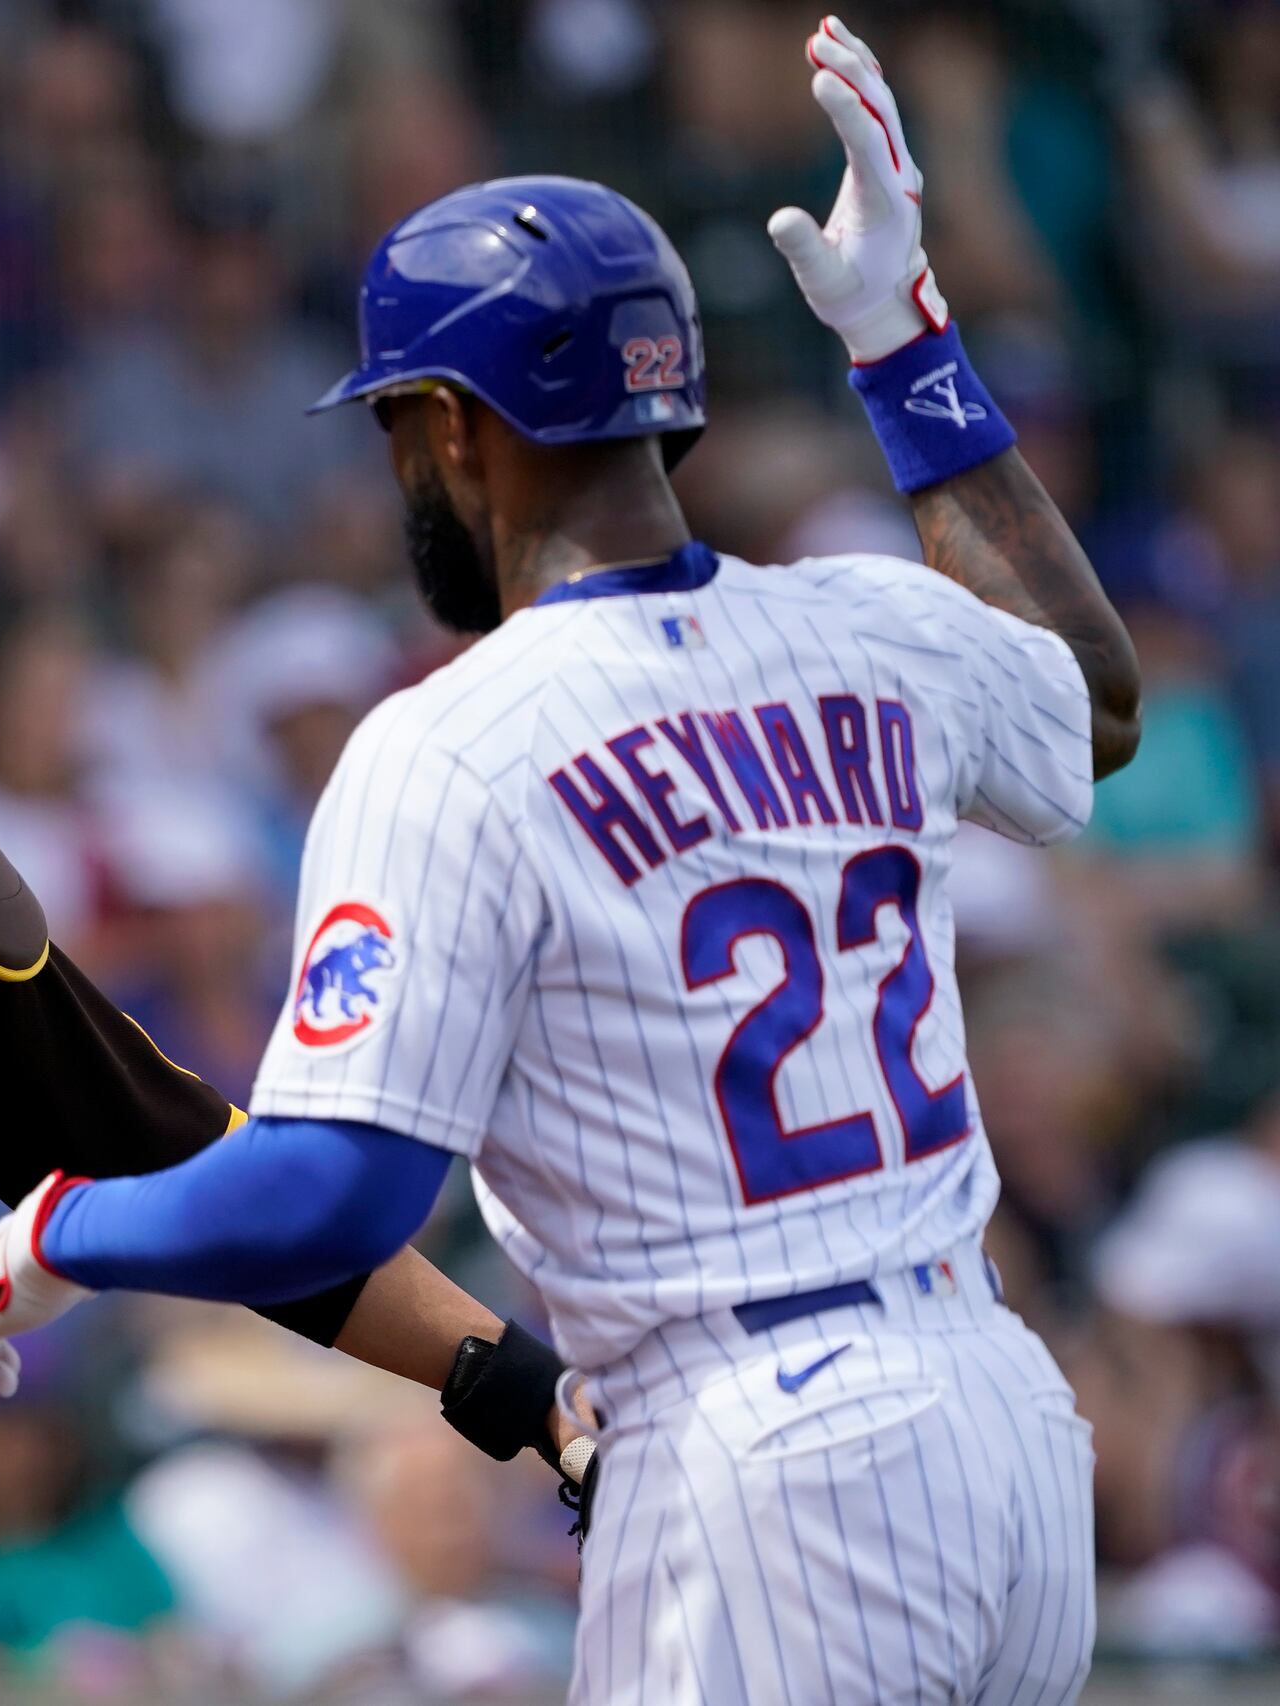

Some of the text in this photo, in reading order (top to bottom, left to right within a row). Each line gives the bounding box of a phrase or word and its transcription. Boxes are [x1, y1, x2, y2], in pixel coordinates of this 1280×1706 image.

[621, 334, 685, 393] 22
[548, 693, 924, 888] HEYWARD
[681, 845, 974, 1209] 22
